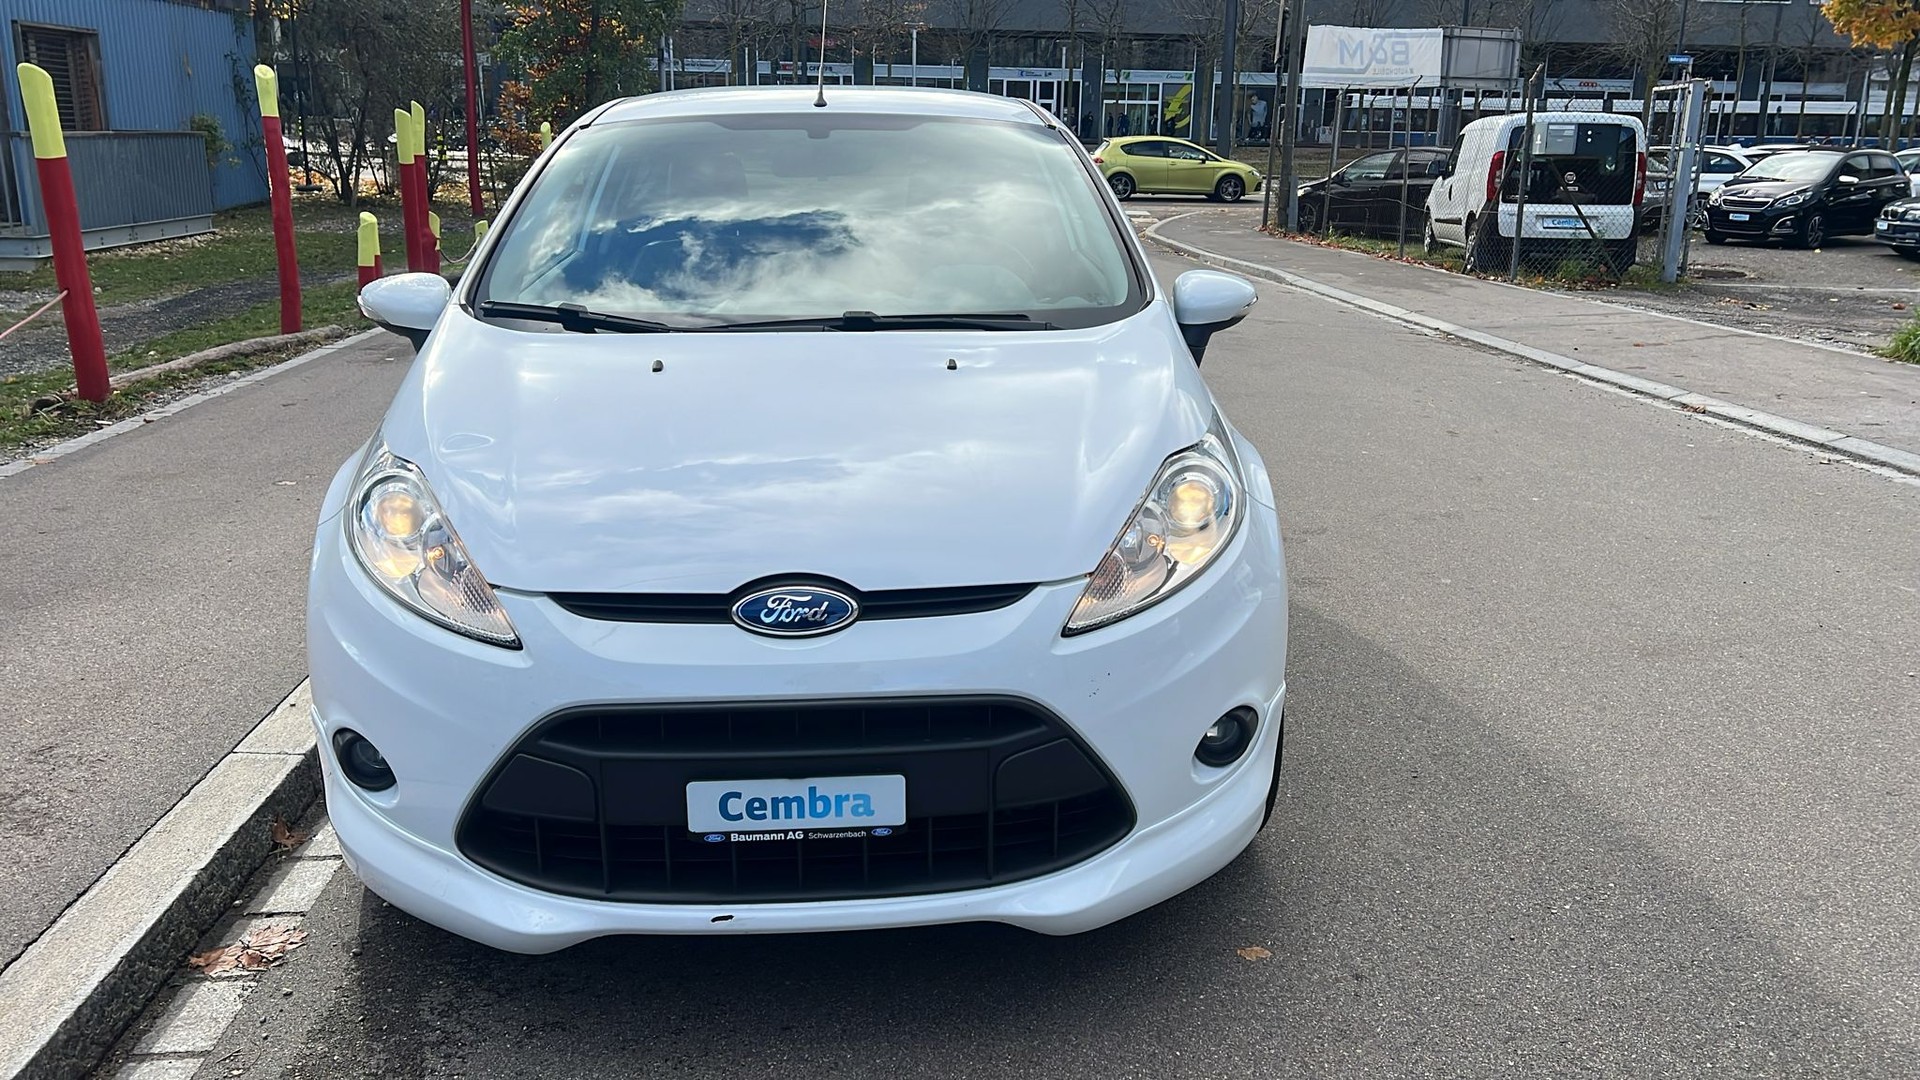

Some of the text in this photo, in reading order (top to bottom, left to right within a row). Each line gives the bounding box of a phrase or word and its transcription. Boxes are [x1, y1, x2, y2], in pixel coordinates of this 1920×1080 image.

[759, 594, 829, 624] Ford
[718, 786, 875, 822] Cembra
[730, 830, 867, 842] Baumann AG Schwarzenbach
